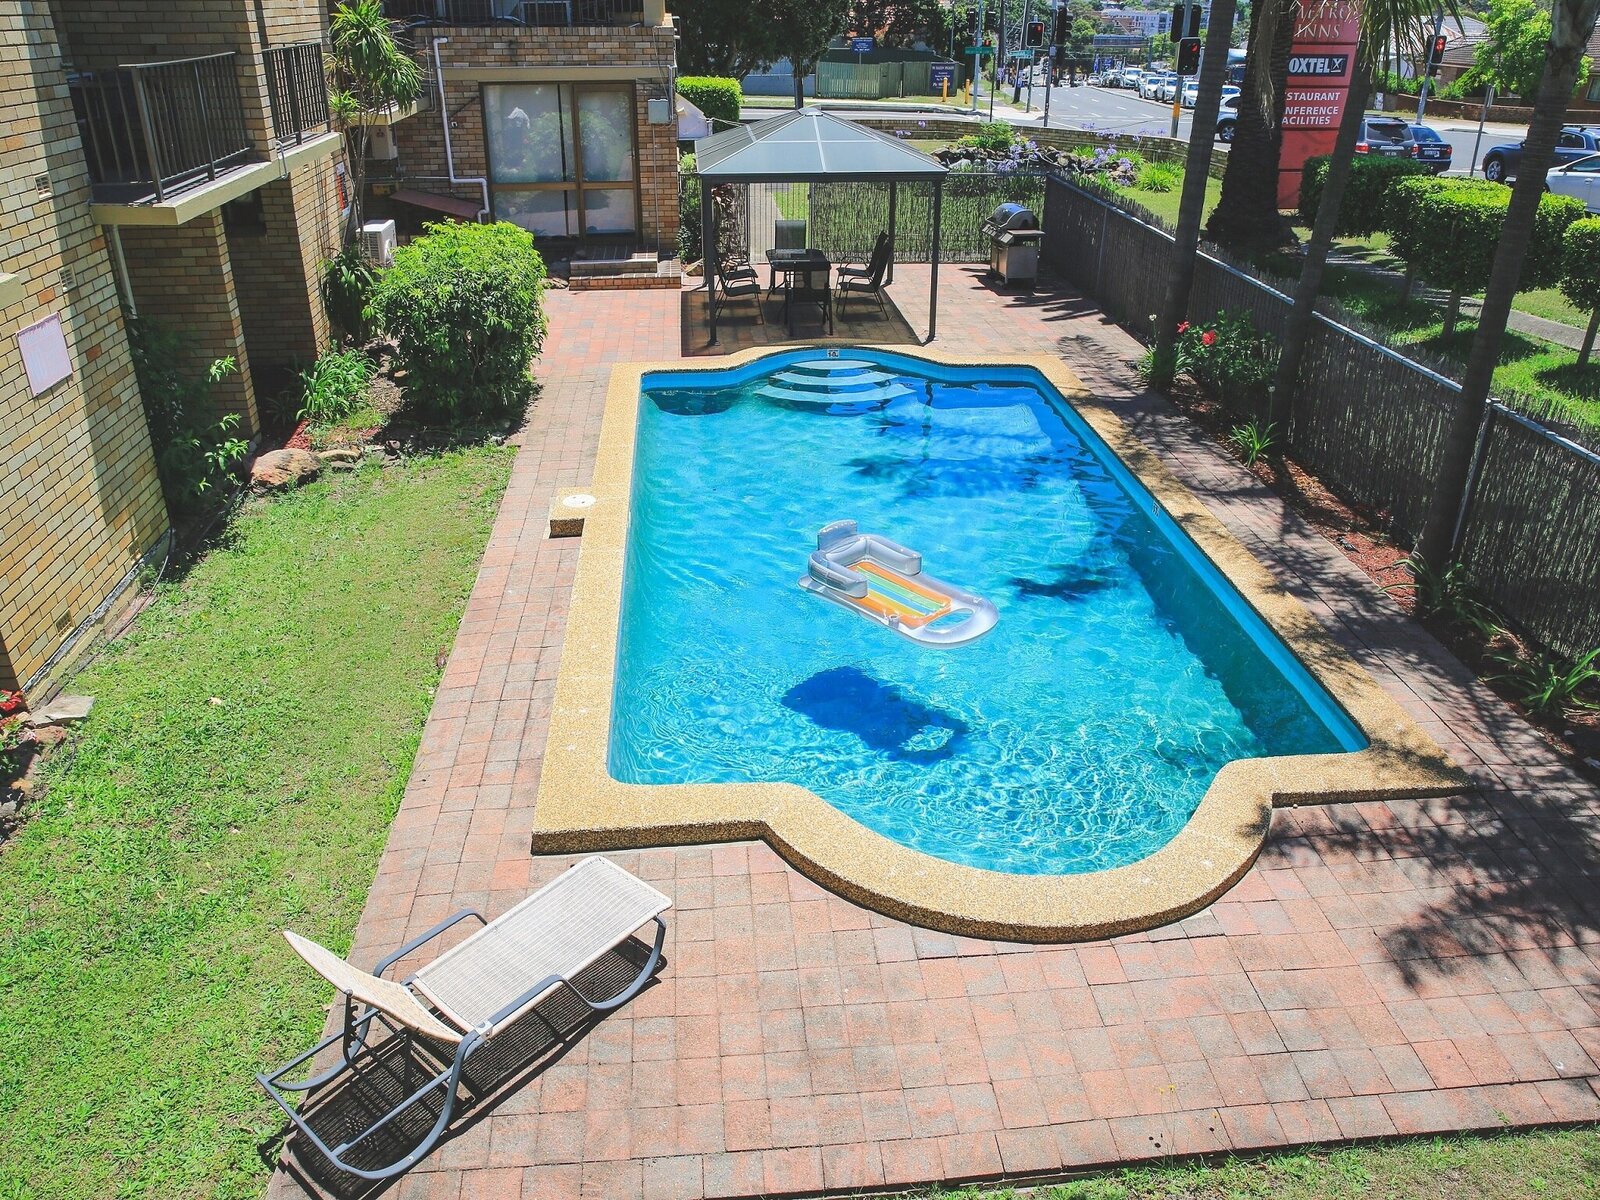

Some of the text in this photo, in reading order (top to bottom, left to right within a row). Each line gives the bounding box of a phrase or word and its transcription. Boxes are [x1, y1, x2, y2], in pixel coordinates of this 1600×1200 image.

[1296, 24, 1341, 38] INNS
[1288, 58, 1330, 73] OXTEL
[1286, 92, 1341, 101] STAURANT
[1285, 106, 1339, 115] NFERENCE
[1281, 116, 1331, 125] ACILITIES
